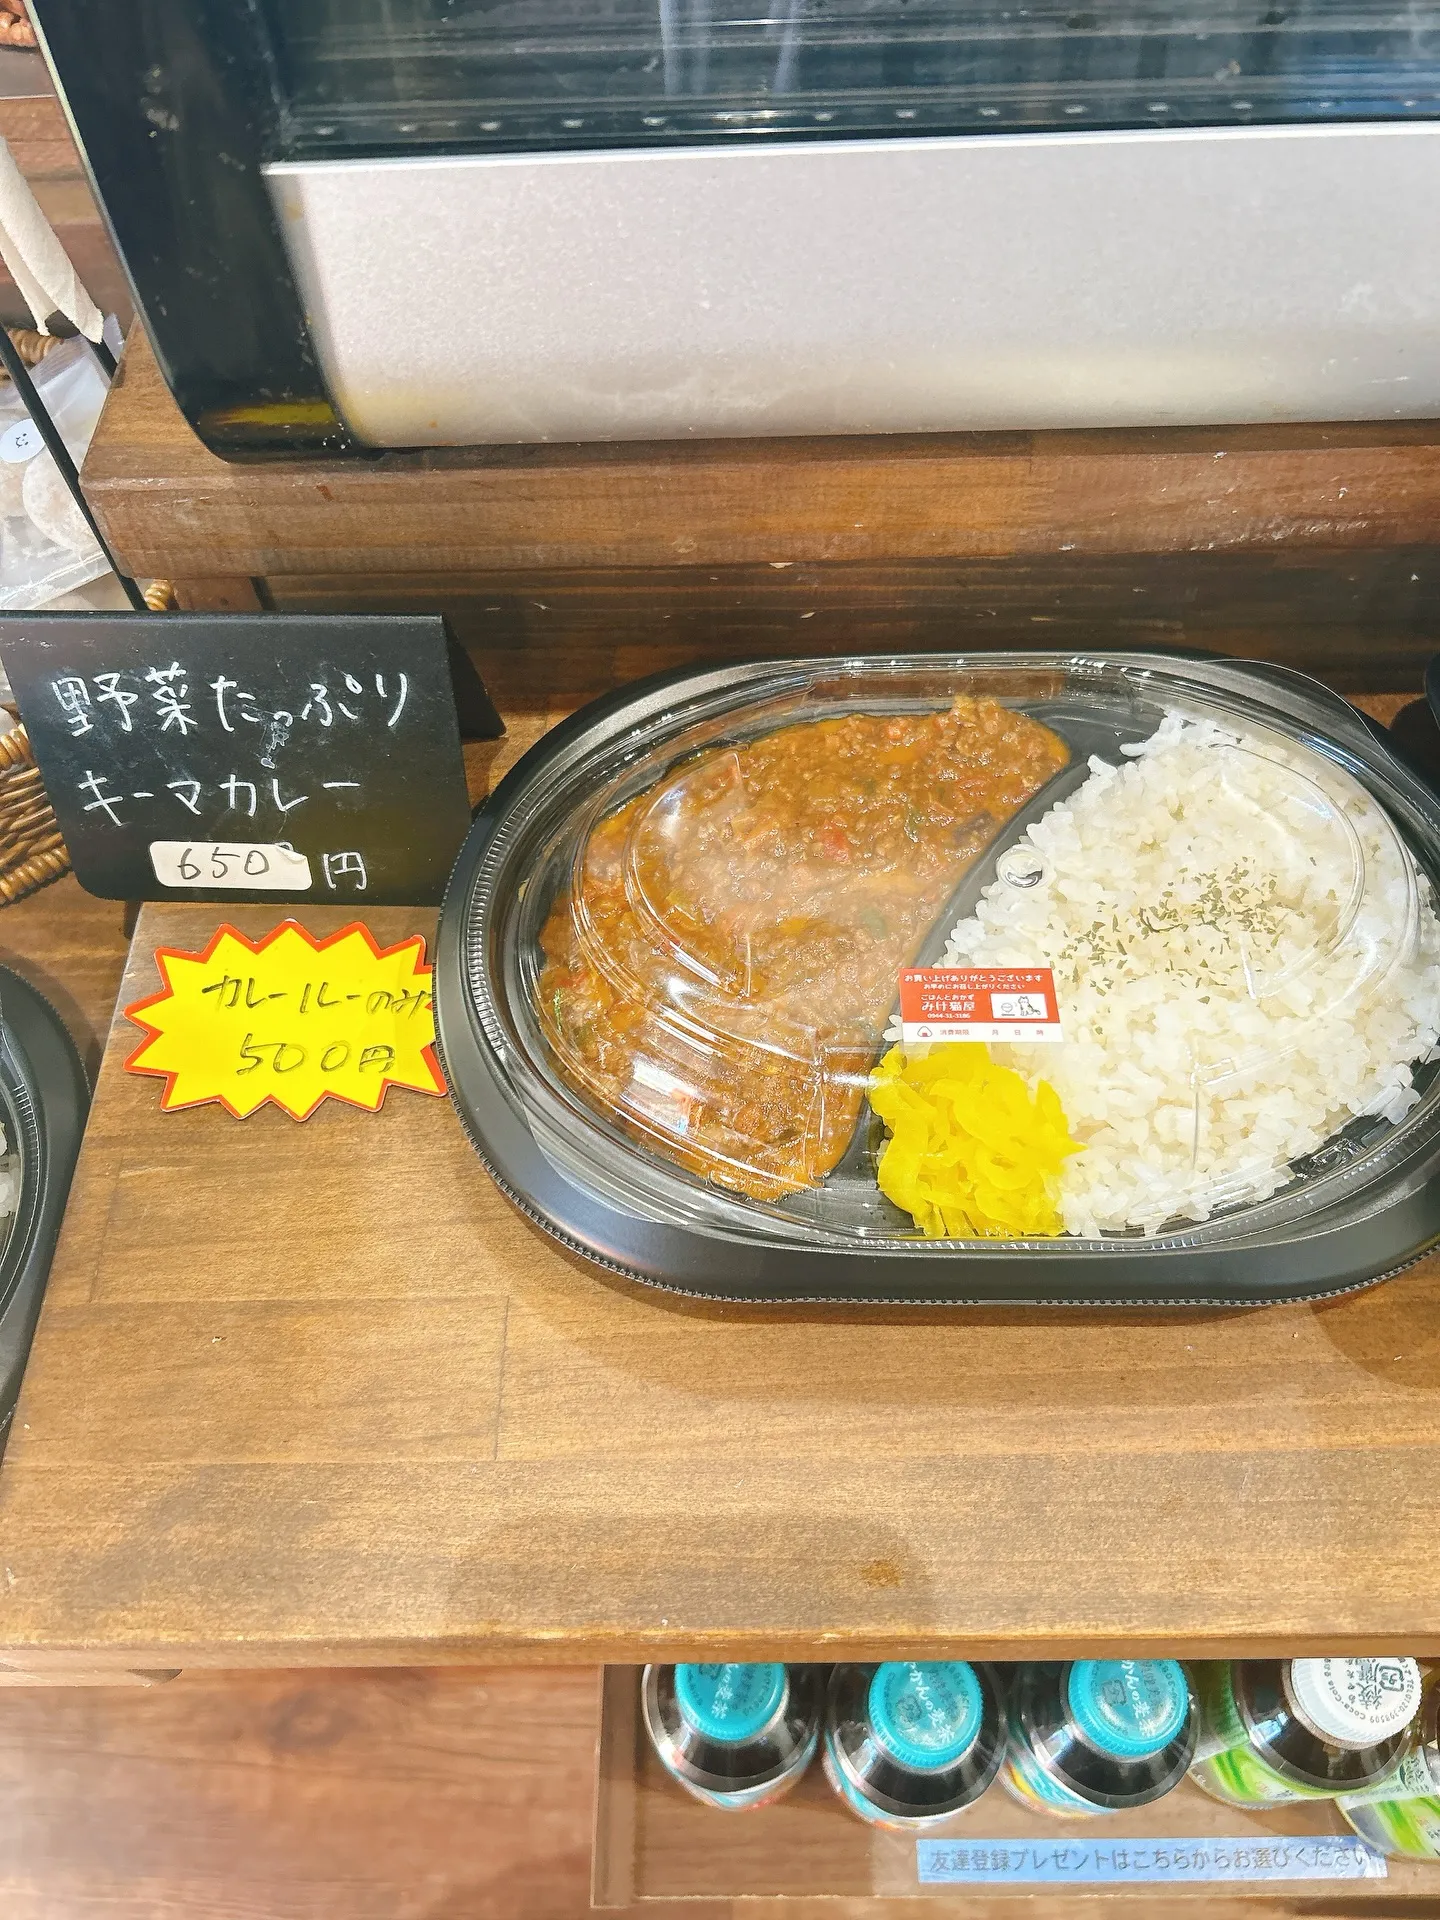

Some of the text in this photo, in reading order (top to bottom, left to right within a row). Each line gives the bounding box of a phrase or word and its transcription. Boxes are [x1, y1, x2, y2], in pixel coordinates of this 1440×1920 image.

[51, 661, 409, 737] 野菜たっぷり
[78, 769, 361, 827] キーマカレー
[904, 974, 1044, 983] お買い上げありがとうございます
[921, 993, 975, 1001] ごはんとおかず
[921, 1000, 976, 1012] みけ猫屋
[236, 1032, 396, 1076] 500円
[930, 1844, 1371, 1872] 友達登録プレゼントはこちらからお選びください
